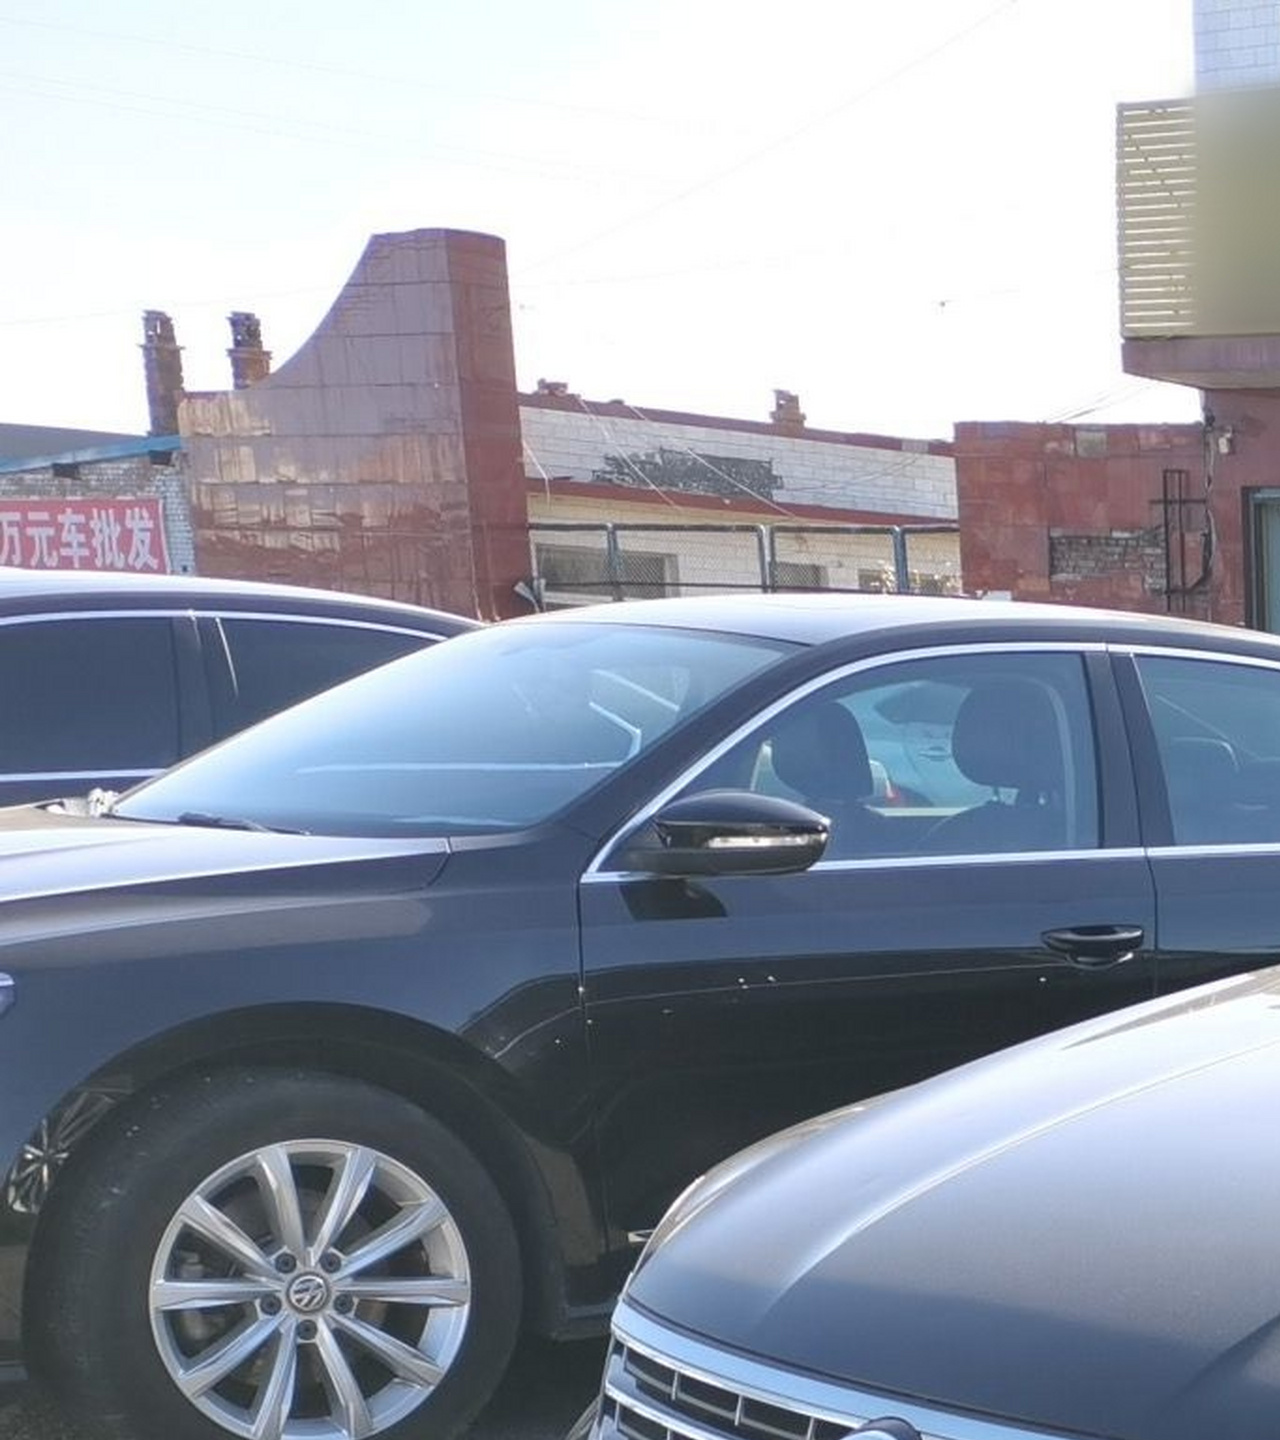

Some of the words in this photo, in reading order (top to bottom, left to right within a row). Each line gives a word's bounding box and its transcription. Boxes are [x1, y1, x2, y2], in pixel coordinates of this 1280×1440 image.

[0, 507, 159, 570] 万元车批发
